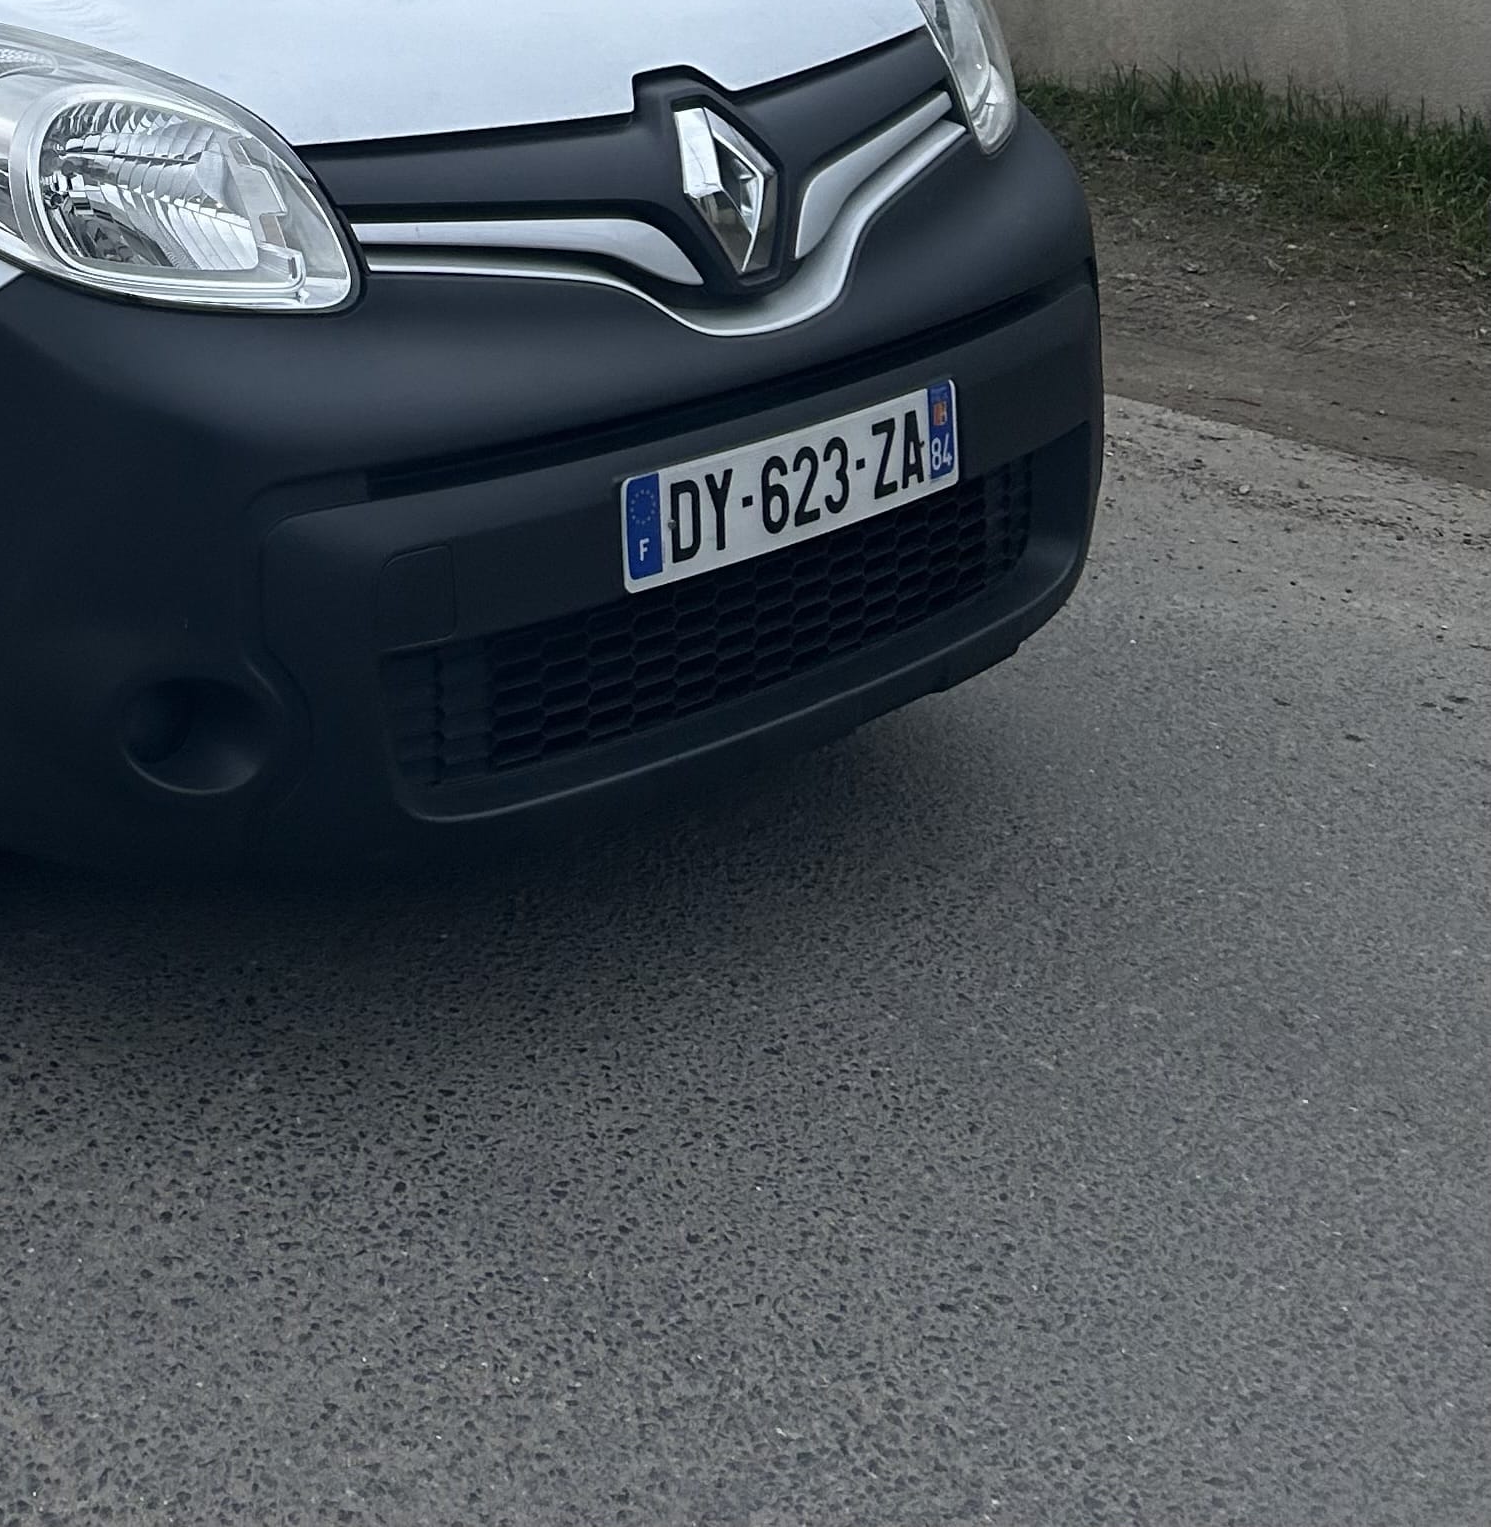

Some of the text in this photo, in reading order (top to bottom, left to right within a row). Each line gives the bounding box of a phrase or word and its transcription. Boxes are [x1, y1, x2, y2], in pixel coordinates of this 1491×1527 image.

[931, 433, 953, 470] 84
[670, 410, 925, 564] DY-623-ZA
[638, 538, 650, 561] F
